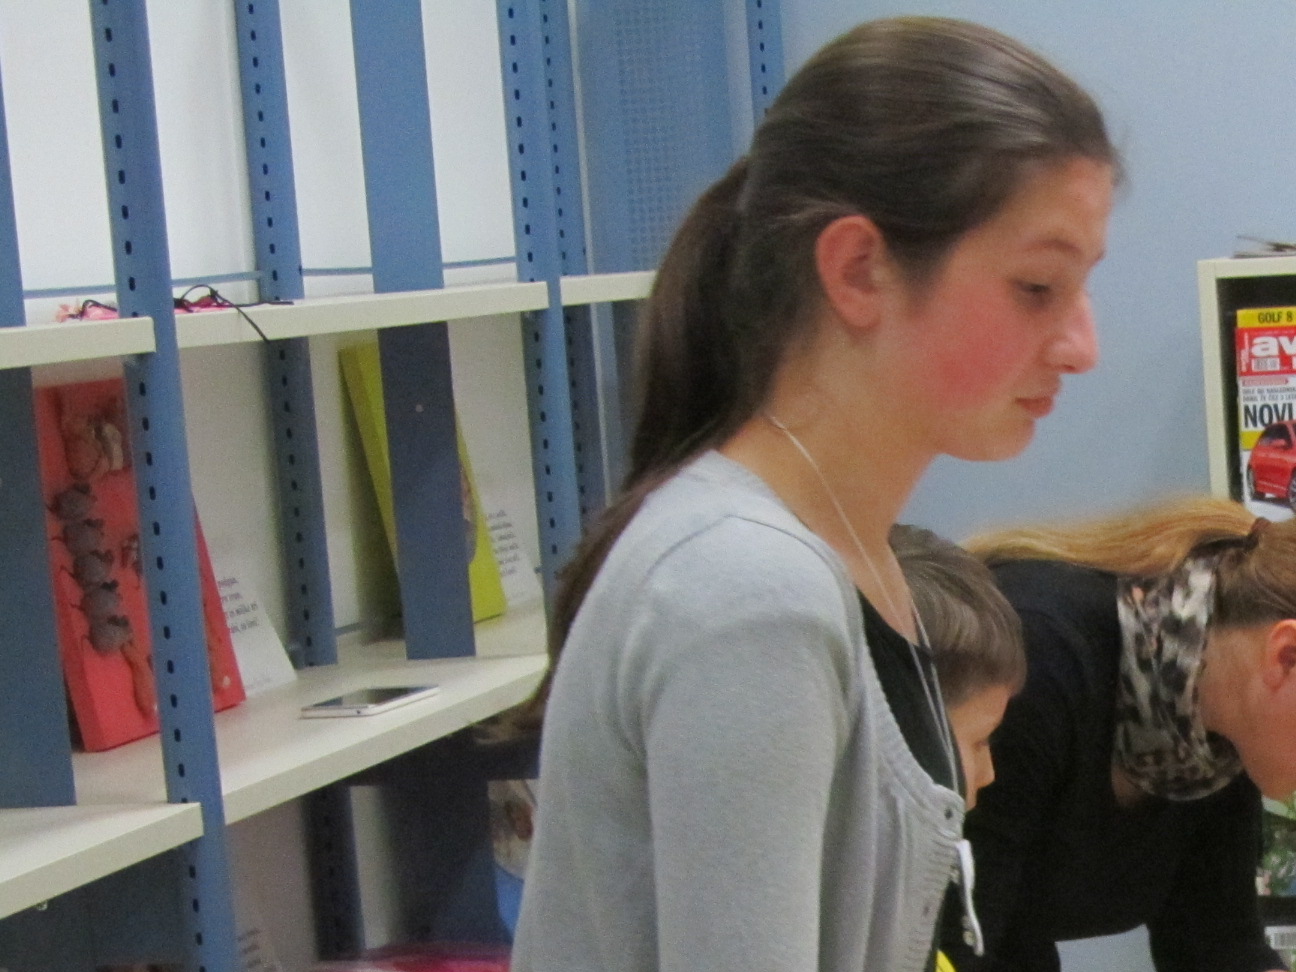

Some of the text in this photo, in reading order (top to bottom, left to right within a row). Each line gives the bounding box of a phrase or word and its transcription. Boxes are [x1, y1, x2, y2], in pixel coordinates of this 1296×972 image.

[1257, 312, 1283, 324] GOLF
[1286, 311, 1293, 322] 8
[1243, 401, 1294, 429] NOVI
